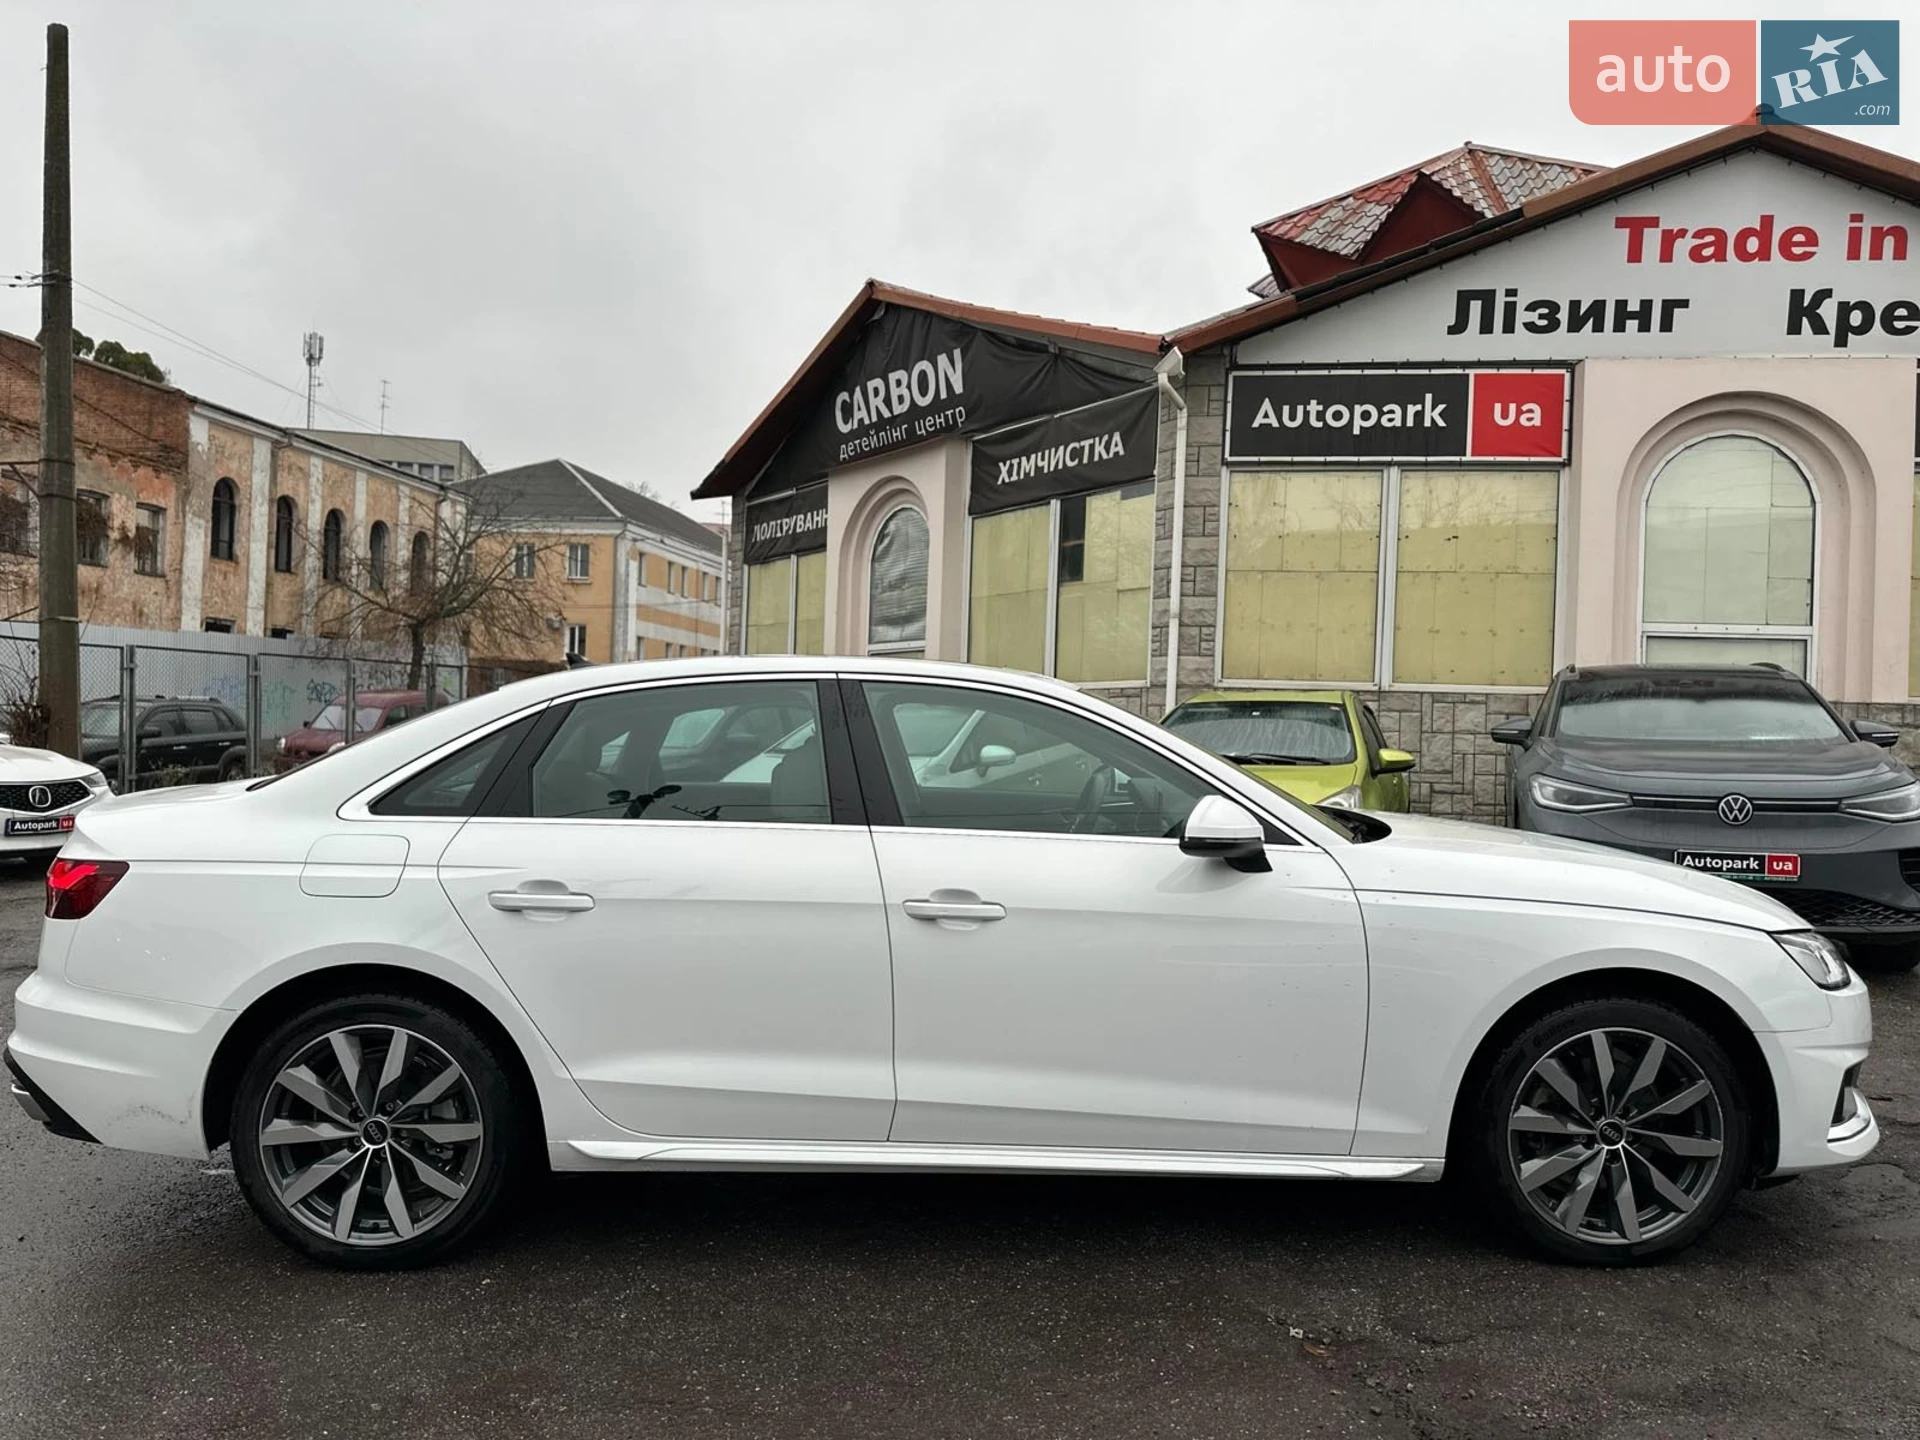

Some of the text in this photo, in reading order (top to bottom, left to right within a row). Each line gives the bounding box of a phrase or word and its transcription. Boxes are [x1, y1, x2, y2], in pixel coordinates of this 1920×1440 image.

[1614, 213, 1909, 264] Trade in
[1447, 288, 1690, 335] Лізинг
[1786, 288, 1920, 349] Кре
[834, 347, 964, 434] CARBON
[1251, 393, 1542, 435] Autopark ua
[839, 405, 967, 462] детейлінг центр
[996, 431, 1125, 485] ХІМЧИСТКА
[13, 820, 58, 831] Autopark
[1682, 854, 1793, 871] Autopark ua
